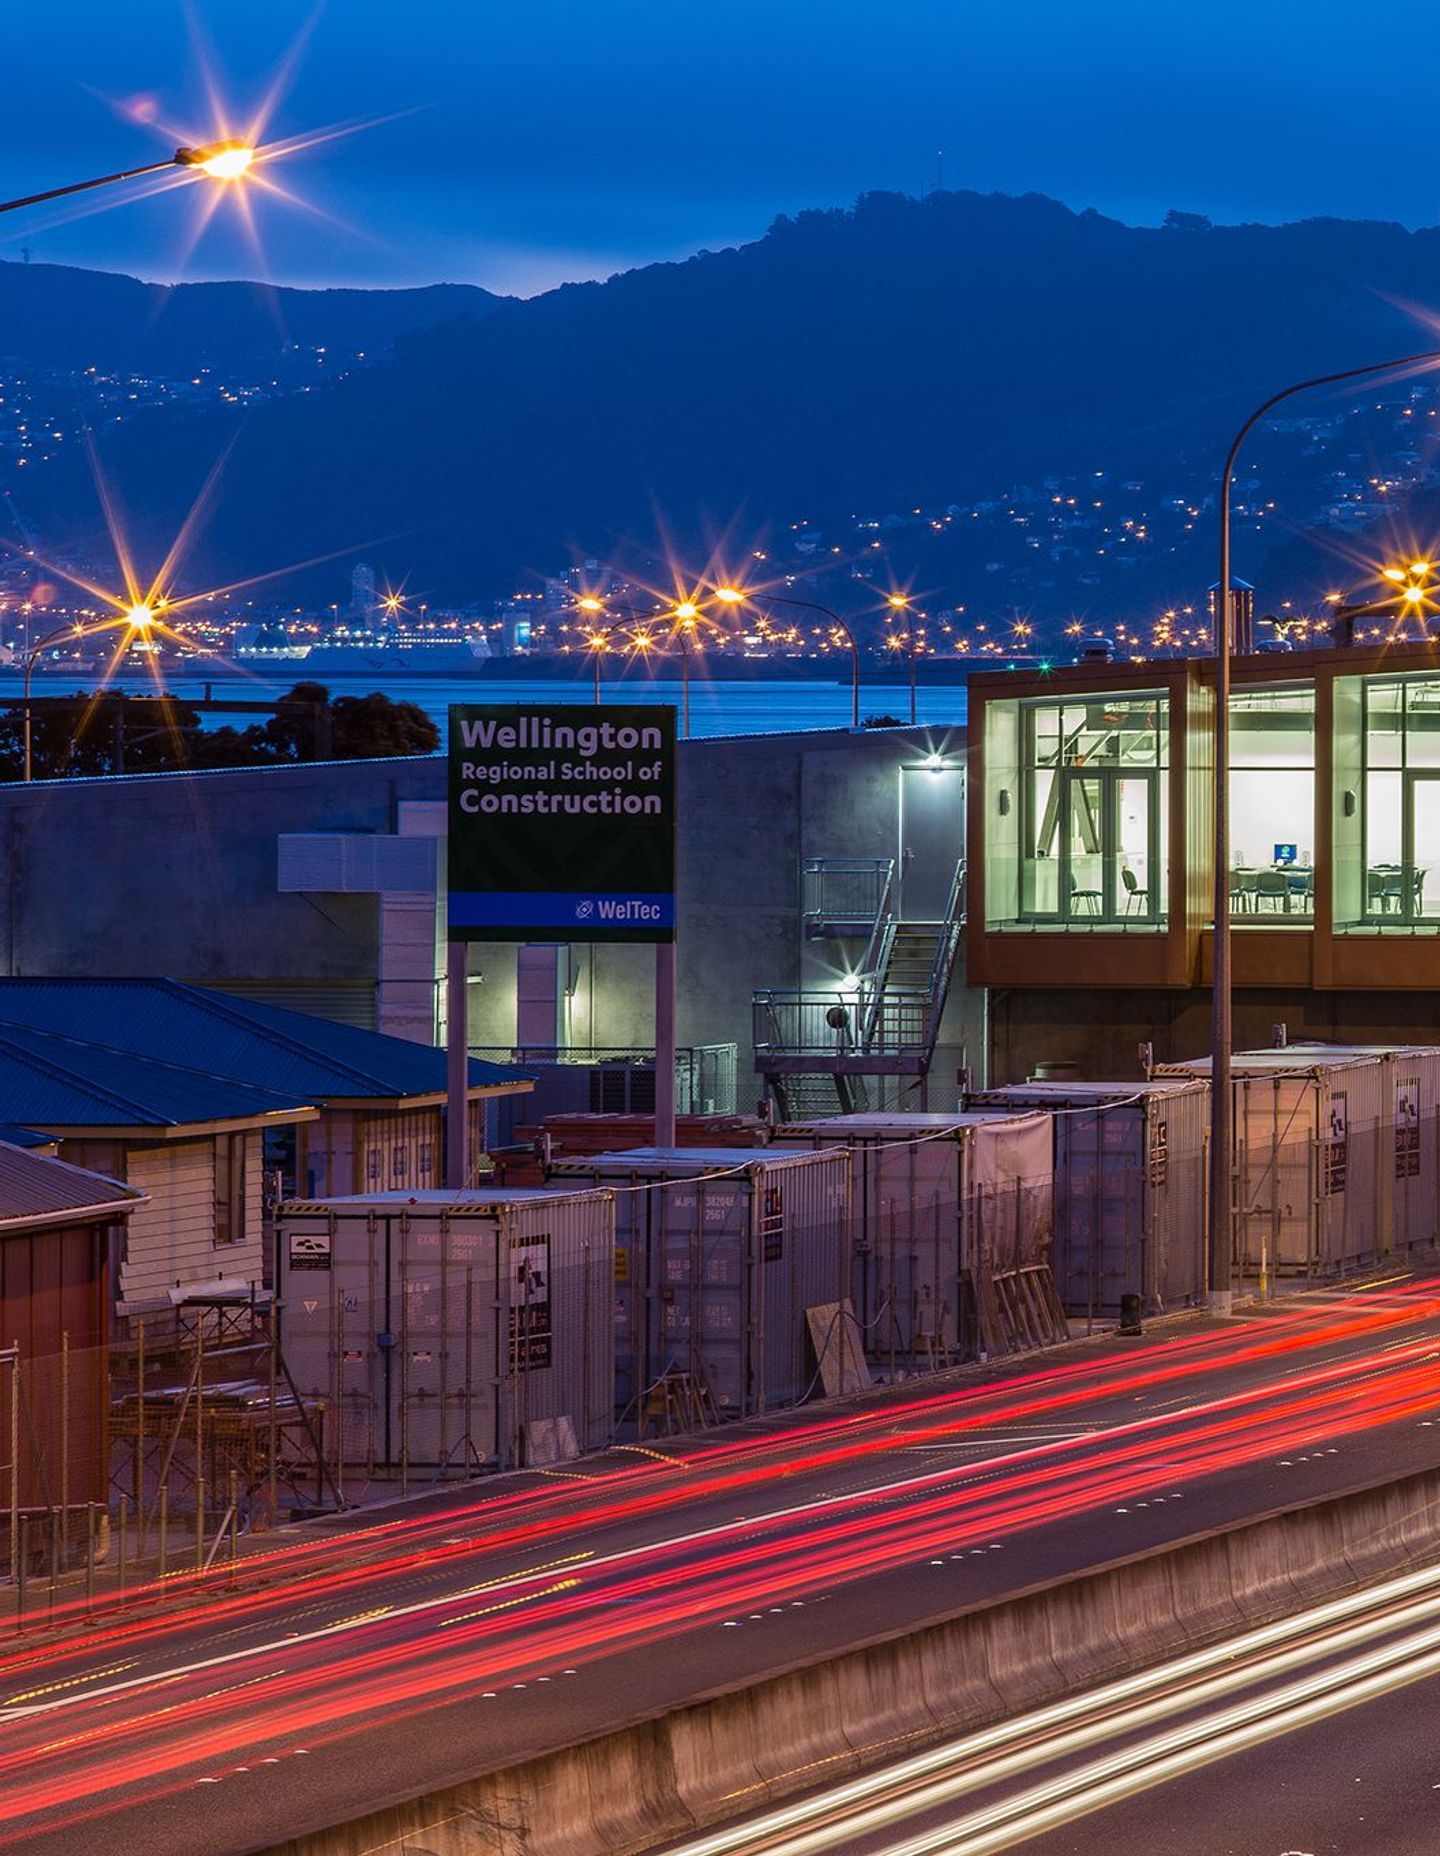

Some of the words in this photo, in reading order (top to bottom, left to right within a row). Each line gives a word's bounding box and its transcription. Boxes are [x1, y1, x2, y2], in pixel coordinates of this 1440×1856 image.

[460, 717, 662, 757] Wellington
[462, 761, 555, 784] Regional
[561, 761, 632, 780] School
[639, 761, 662, 780] of
[459, 788, 662, 814] Construction
[599, 901, 660, 920] WelTec
